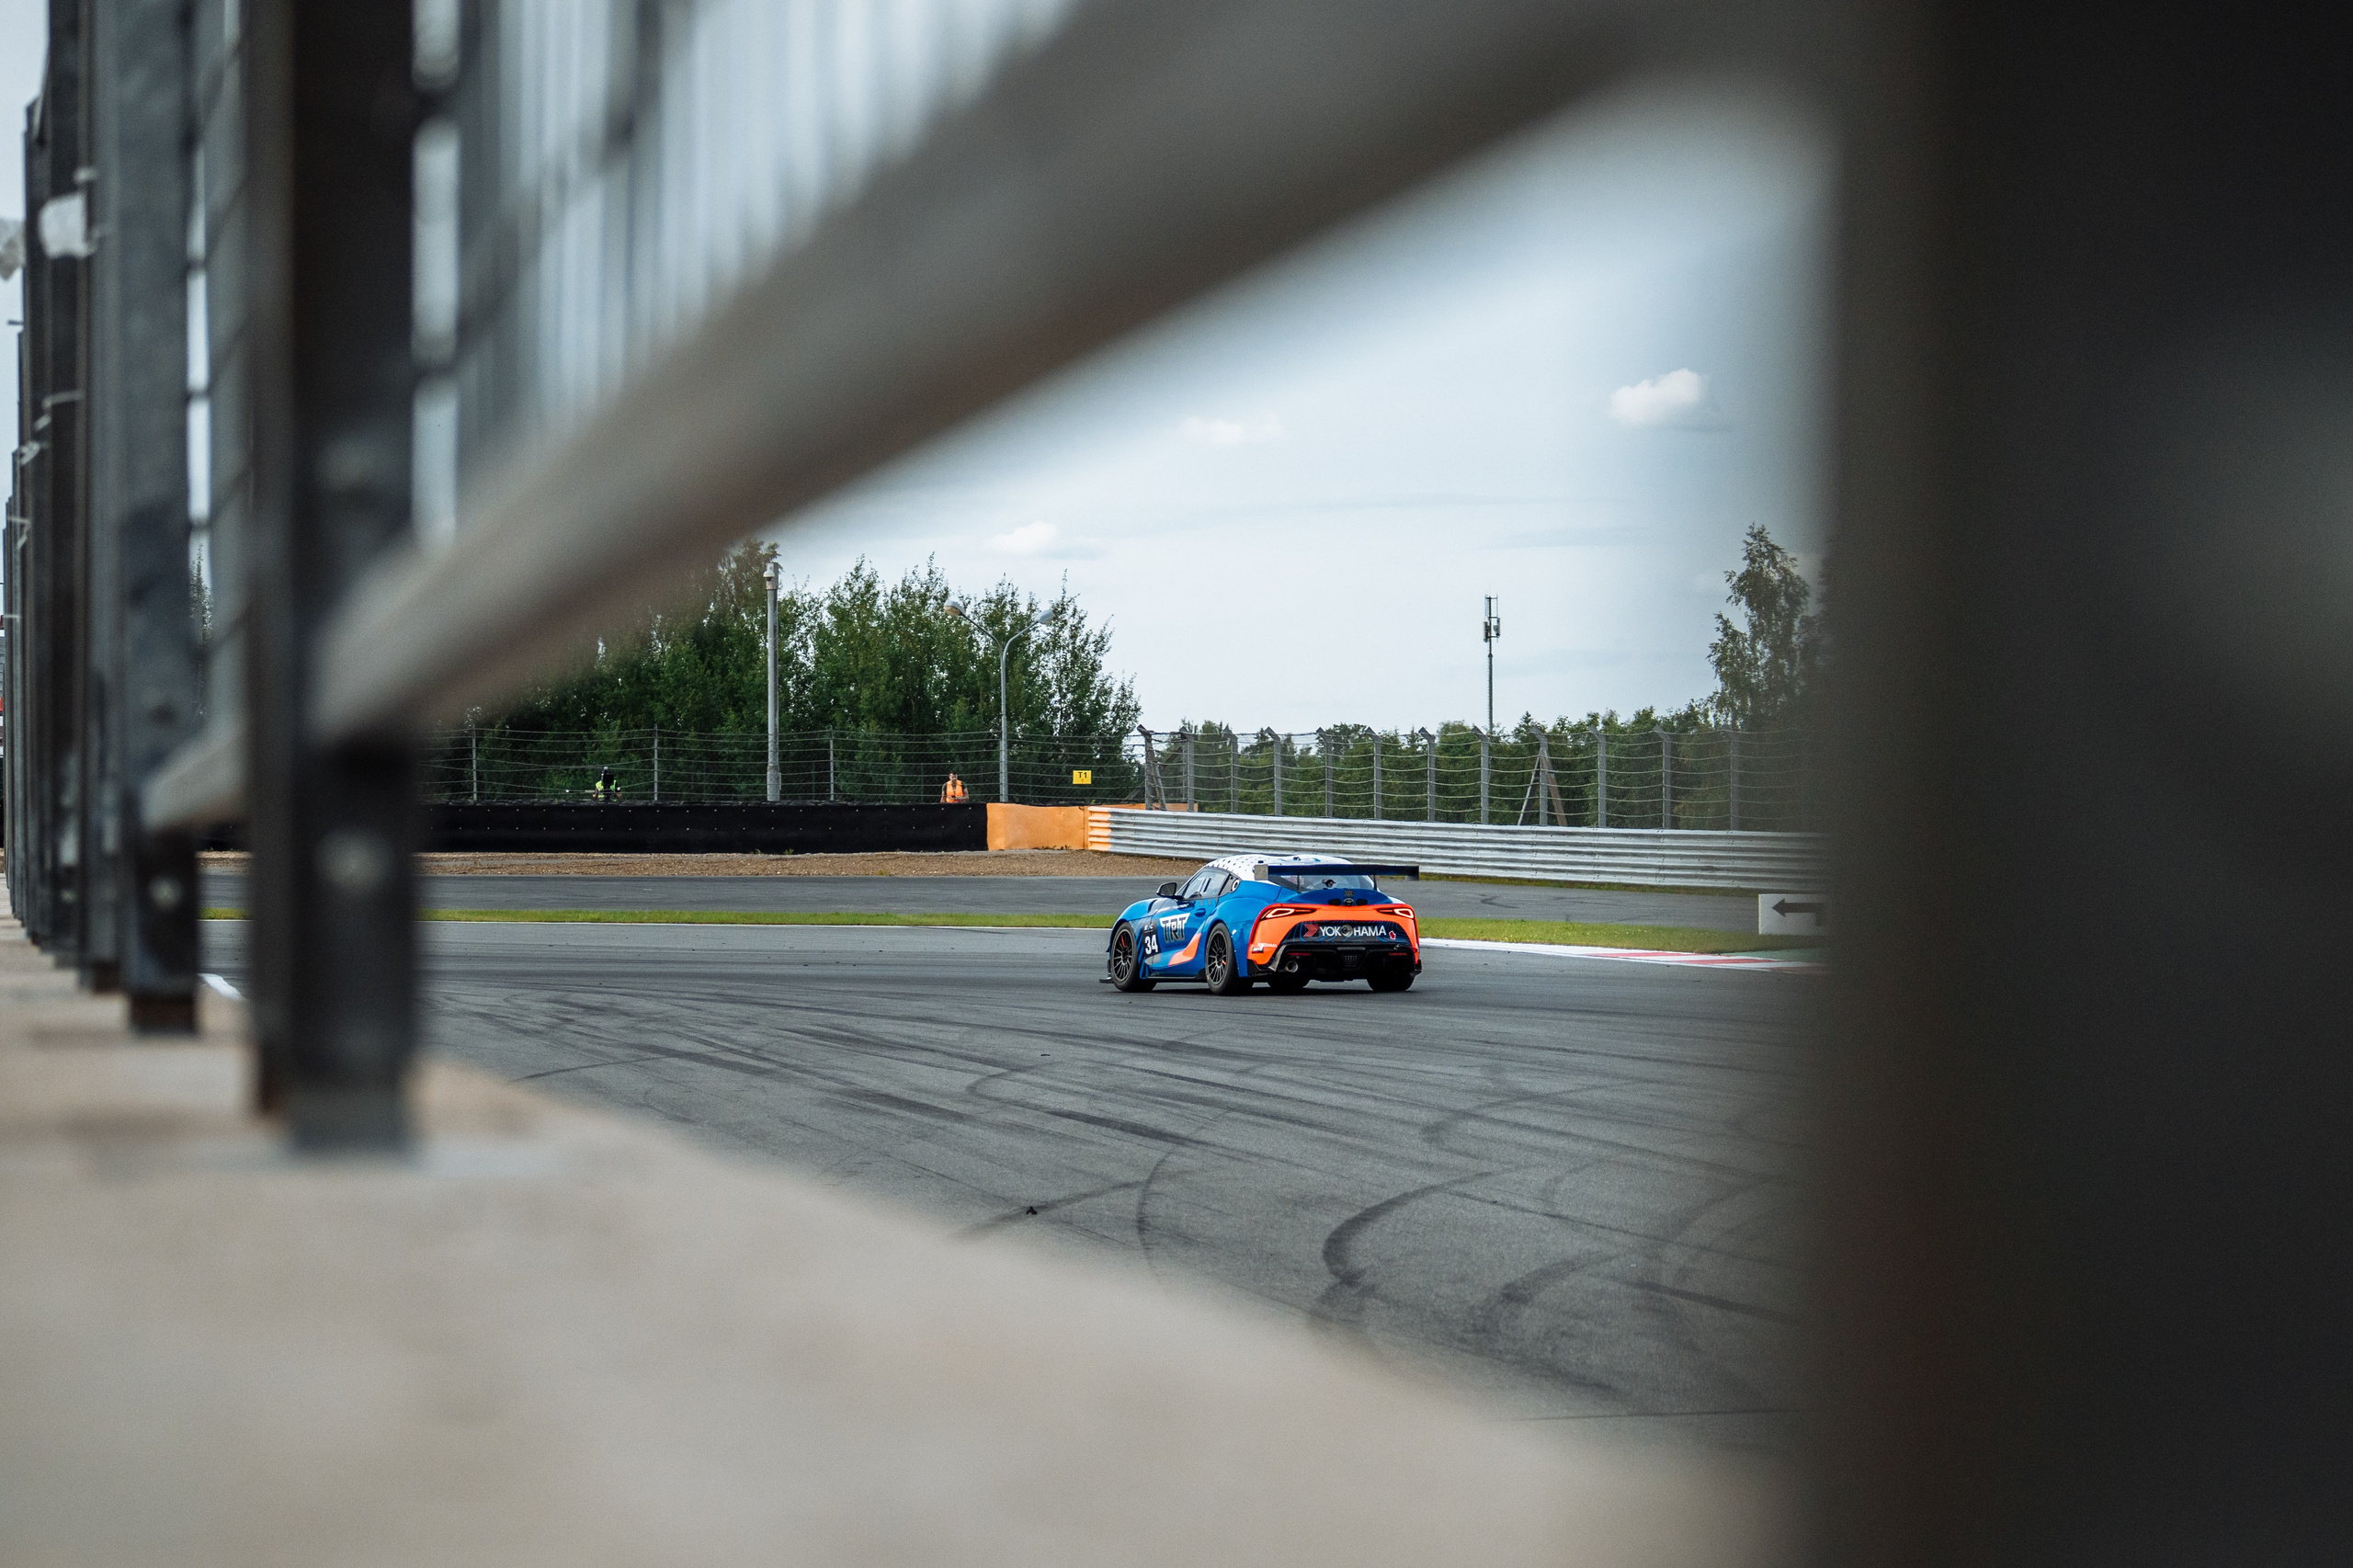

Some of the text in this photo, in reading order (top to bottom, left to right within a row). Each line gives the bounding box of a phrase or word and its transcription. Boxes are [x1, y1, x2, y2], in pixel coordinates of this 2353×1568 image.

[1161, 915, 1188, 942] TRT
[1319, 925, 1387, 937] YOKHAMA
[1144, 934, 1158, 955] 34
